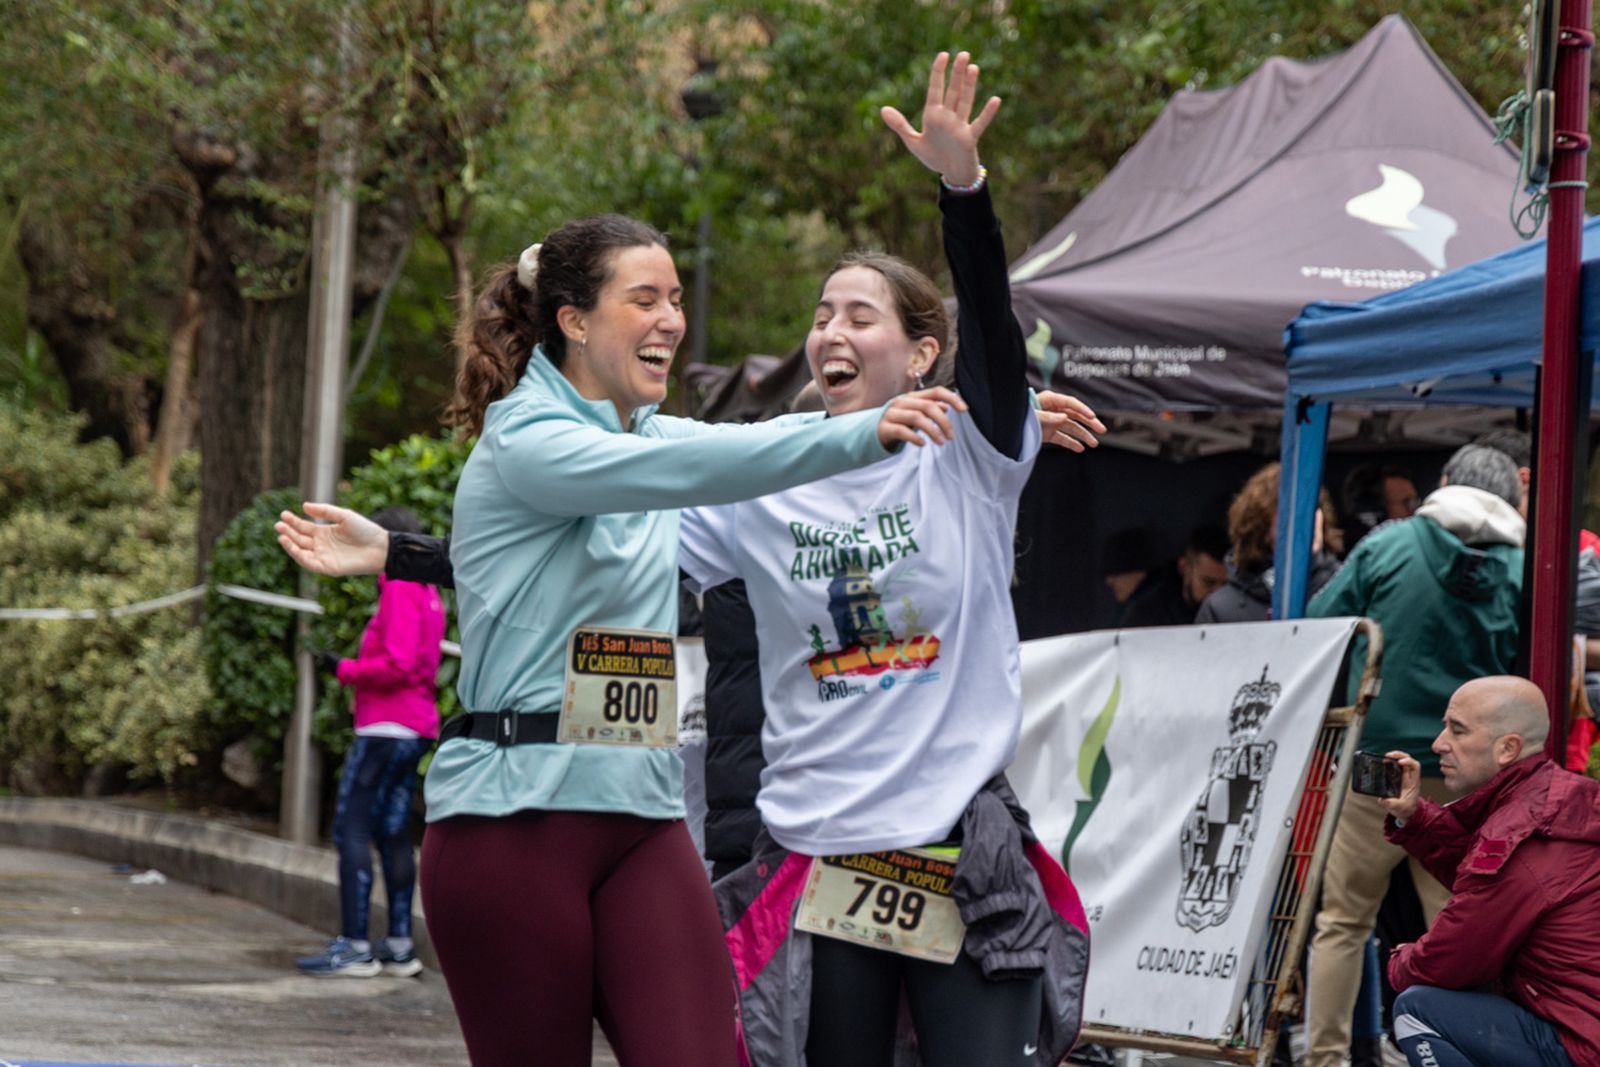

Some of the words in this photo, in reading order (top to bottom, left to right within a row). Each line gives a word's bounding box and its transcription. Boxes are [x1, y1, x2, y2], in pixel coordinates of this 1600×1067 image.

[1062, 345, 1133, 361] Patronato
[1134, 344, 1204, 362] Municipal
[1206, 345, 1227, 362] de
[1064, 361, 1131, 379] Deportes
[1132, 361, 1151, 377] de
[878, 508, 914, 541] DE
[790, 536, 919, 581] AHUMADA
[602, 636, 627, 652] San
[628, 637, 651, 653] Juan
[577, 653, 587, 671] V
[588, 654, 640, 674] CARRERA
[641, 657, 674, 676] POPULA
[603, 680, 658, 725] 800
[841, 855, 901, 881] CARRERA
[889, 851, 922, 869] Juan
[845, 876, 927, 931] 799
[1137, 946, 1186, 974] CIUDAD
[1185, 950, 1205, 977] DE
[1204, 946, 1238, 979] JAÉN
